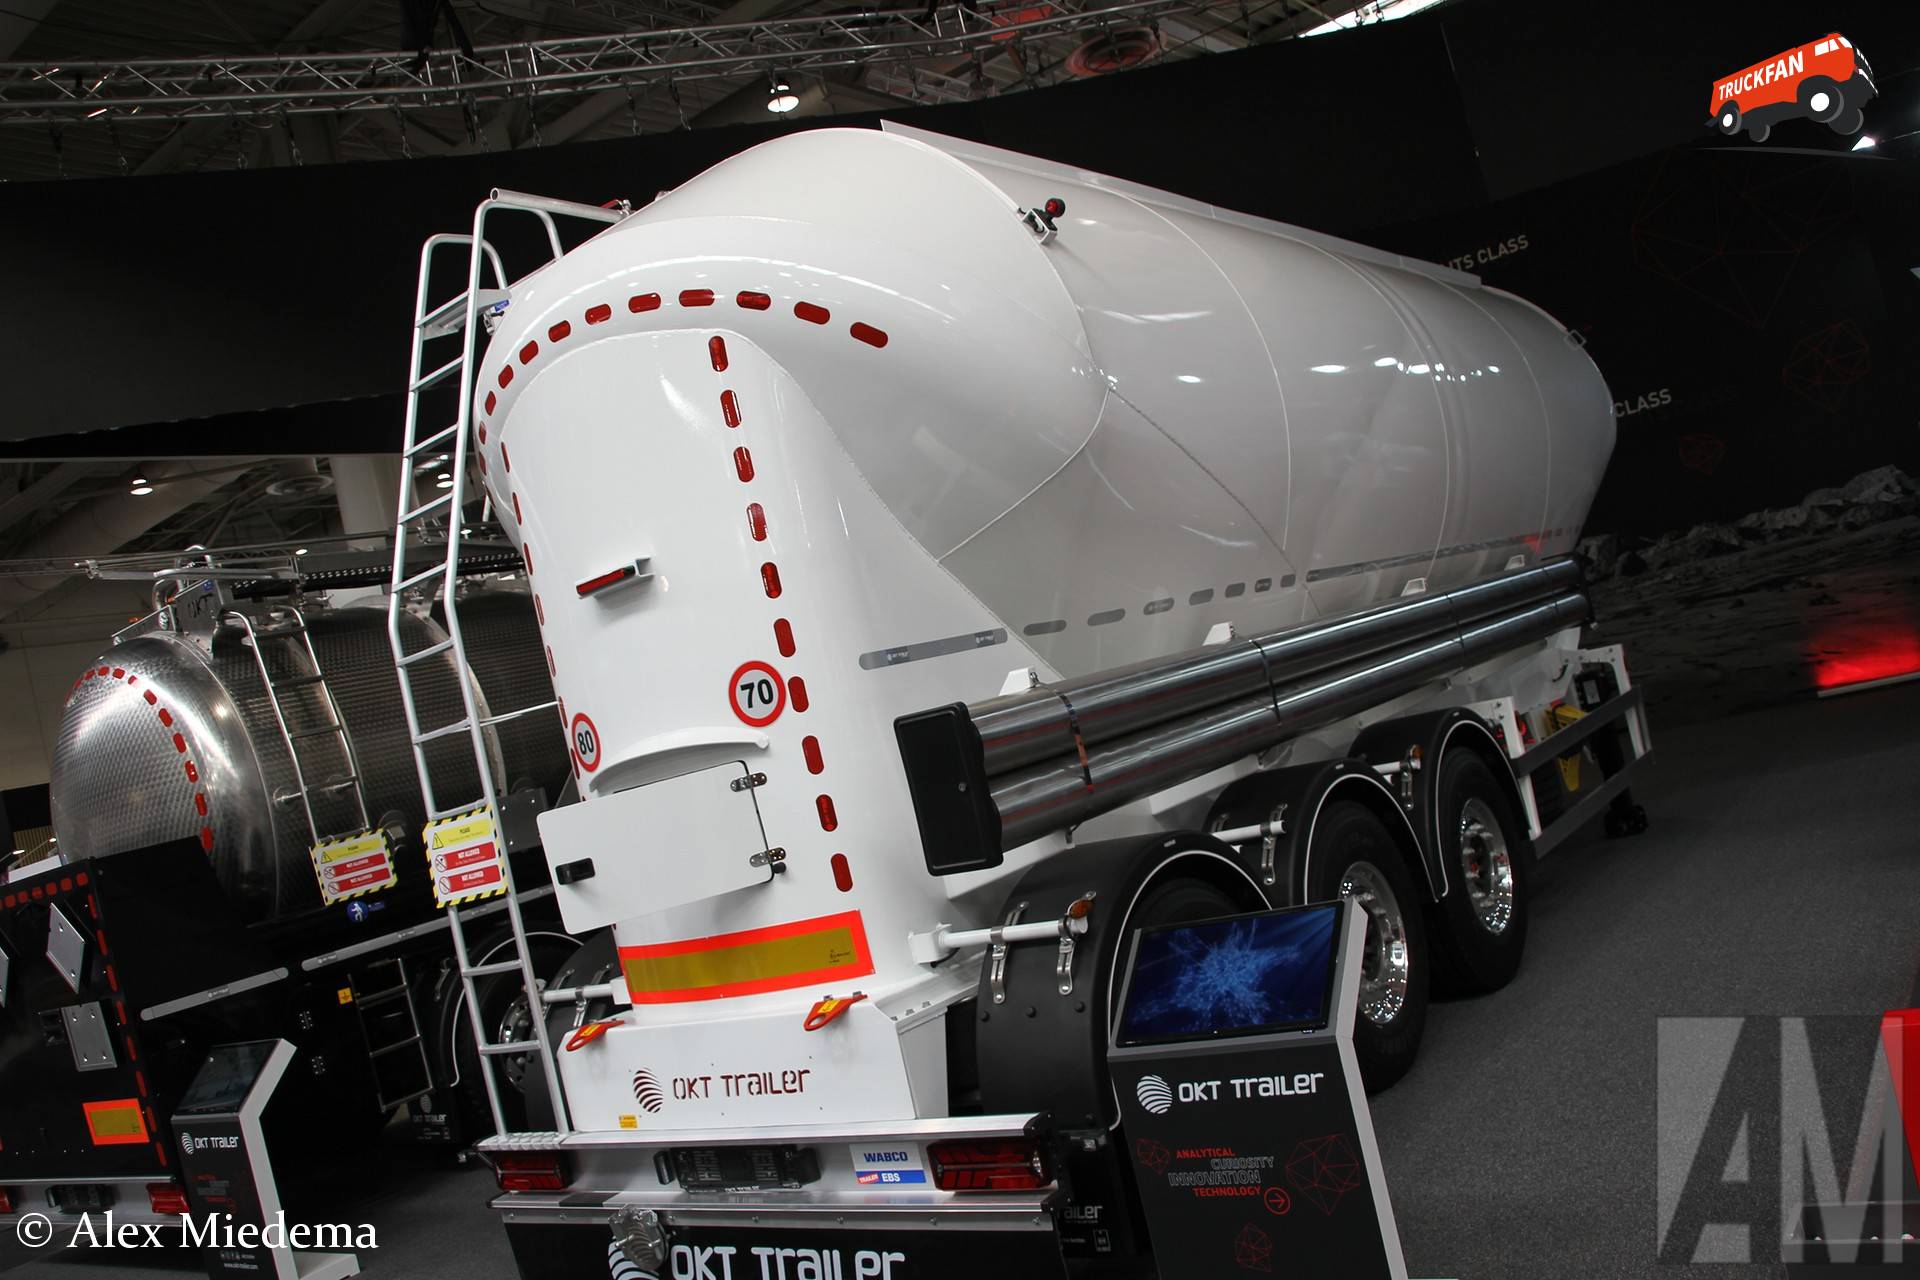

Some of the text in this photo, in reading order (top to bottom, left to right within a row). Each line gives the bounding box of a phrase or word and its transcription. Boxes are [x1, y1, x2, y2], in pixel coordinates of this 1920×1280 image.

[1477, 234, 1529, 264] CLASS
[1614, 387, 1672, 418] CLASS
[740, 678, 774, 709] 70
[577, 729, 594, 756] 80
[673, 1076, 712, 1100] OKT
[1178, 1080, 1221, 1103] OKT
[863, 1151, 908, 1163] WABCO
[1176, 1147, 1235, 1159] ANALYTICAL
[1210, 1156, 1275, 1170] CURIOSITY
[881, 1172, 901, 1182] EBS
[1168, 1170, 1262, 1187] INNOVATION
[1192, 1185, 1263, 1198] TECHNOLOGY
[671, 1244, 737, 1280] OKT
